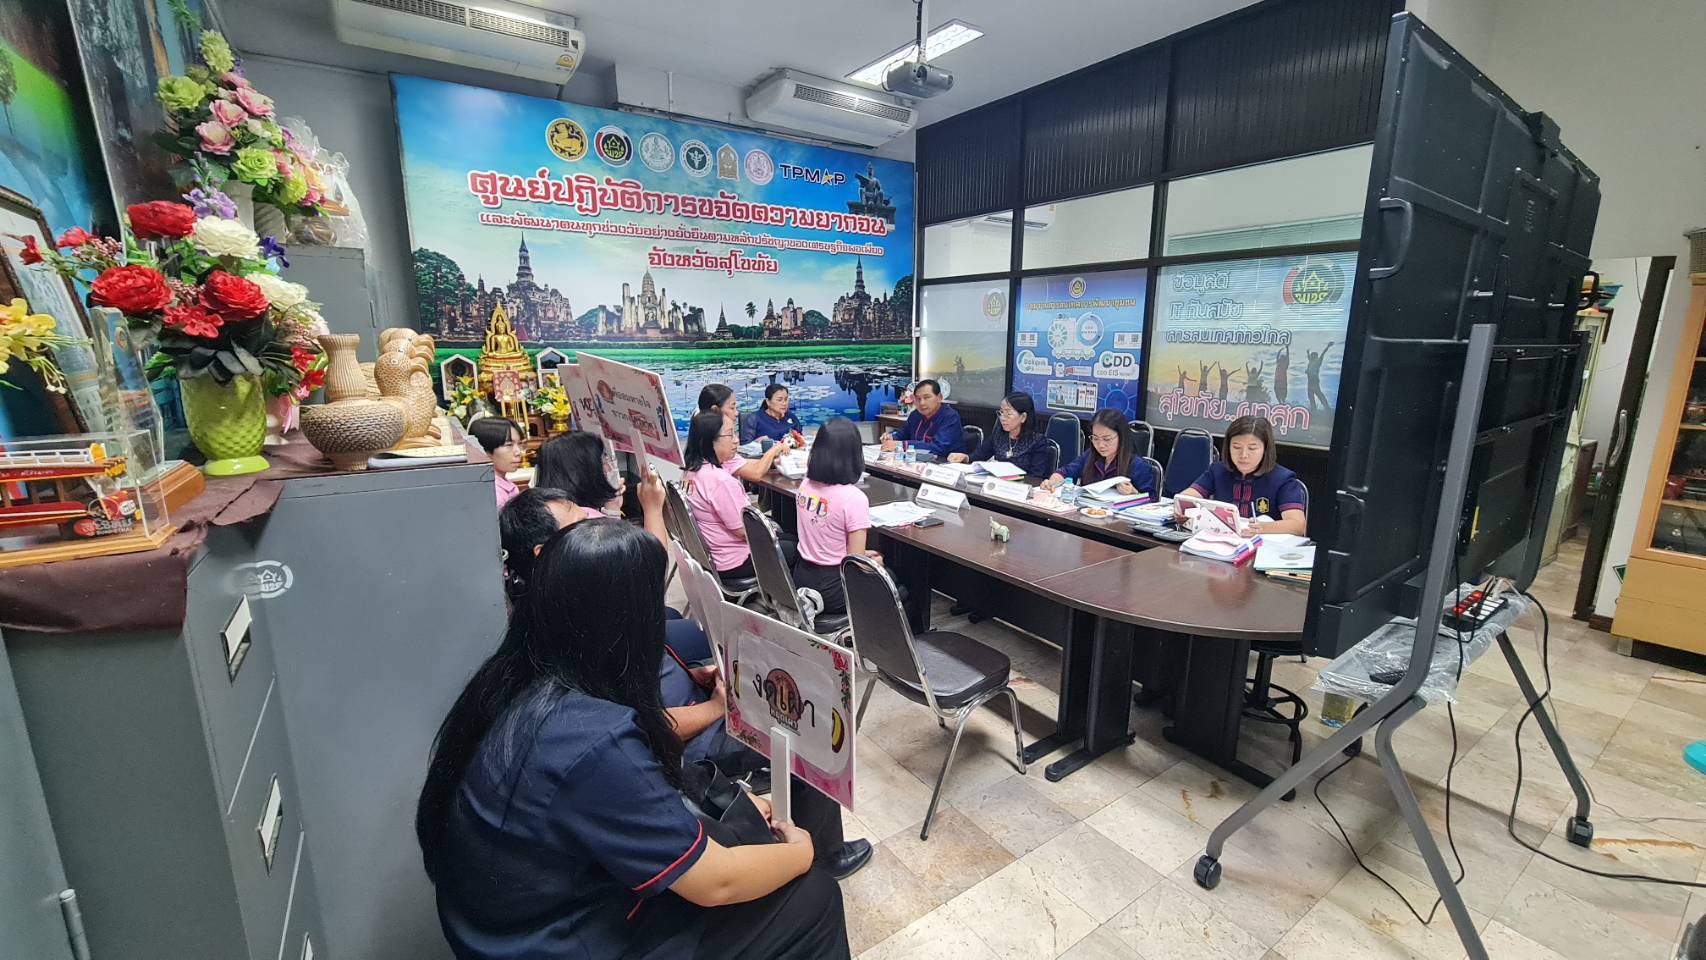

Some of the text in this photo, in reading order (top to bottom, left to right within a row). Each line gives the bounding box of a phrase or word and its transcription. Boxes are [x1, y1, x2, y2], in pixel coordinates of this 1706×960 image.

[469, 167, 888, 236] ศูนย์ปฏิบัติการขจัดความยากจน
[648, 246, 779, 277] จังหวัดสุโขทัย
[1169, 301, 1184, 320] IT
[1166, 324, 1292, 345] สารสนเทศก้าวไกล
[1102, 352, 1132, 368] CDD
